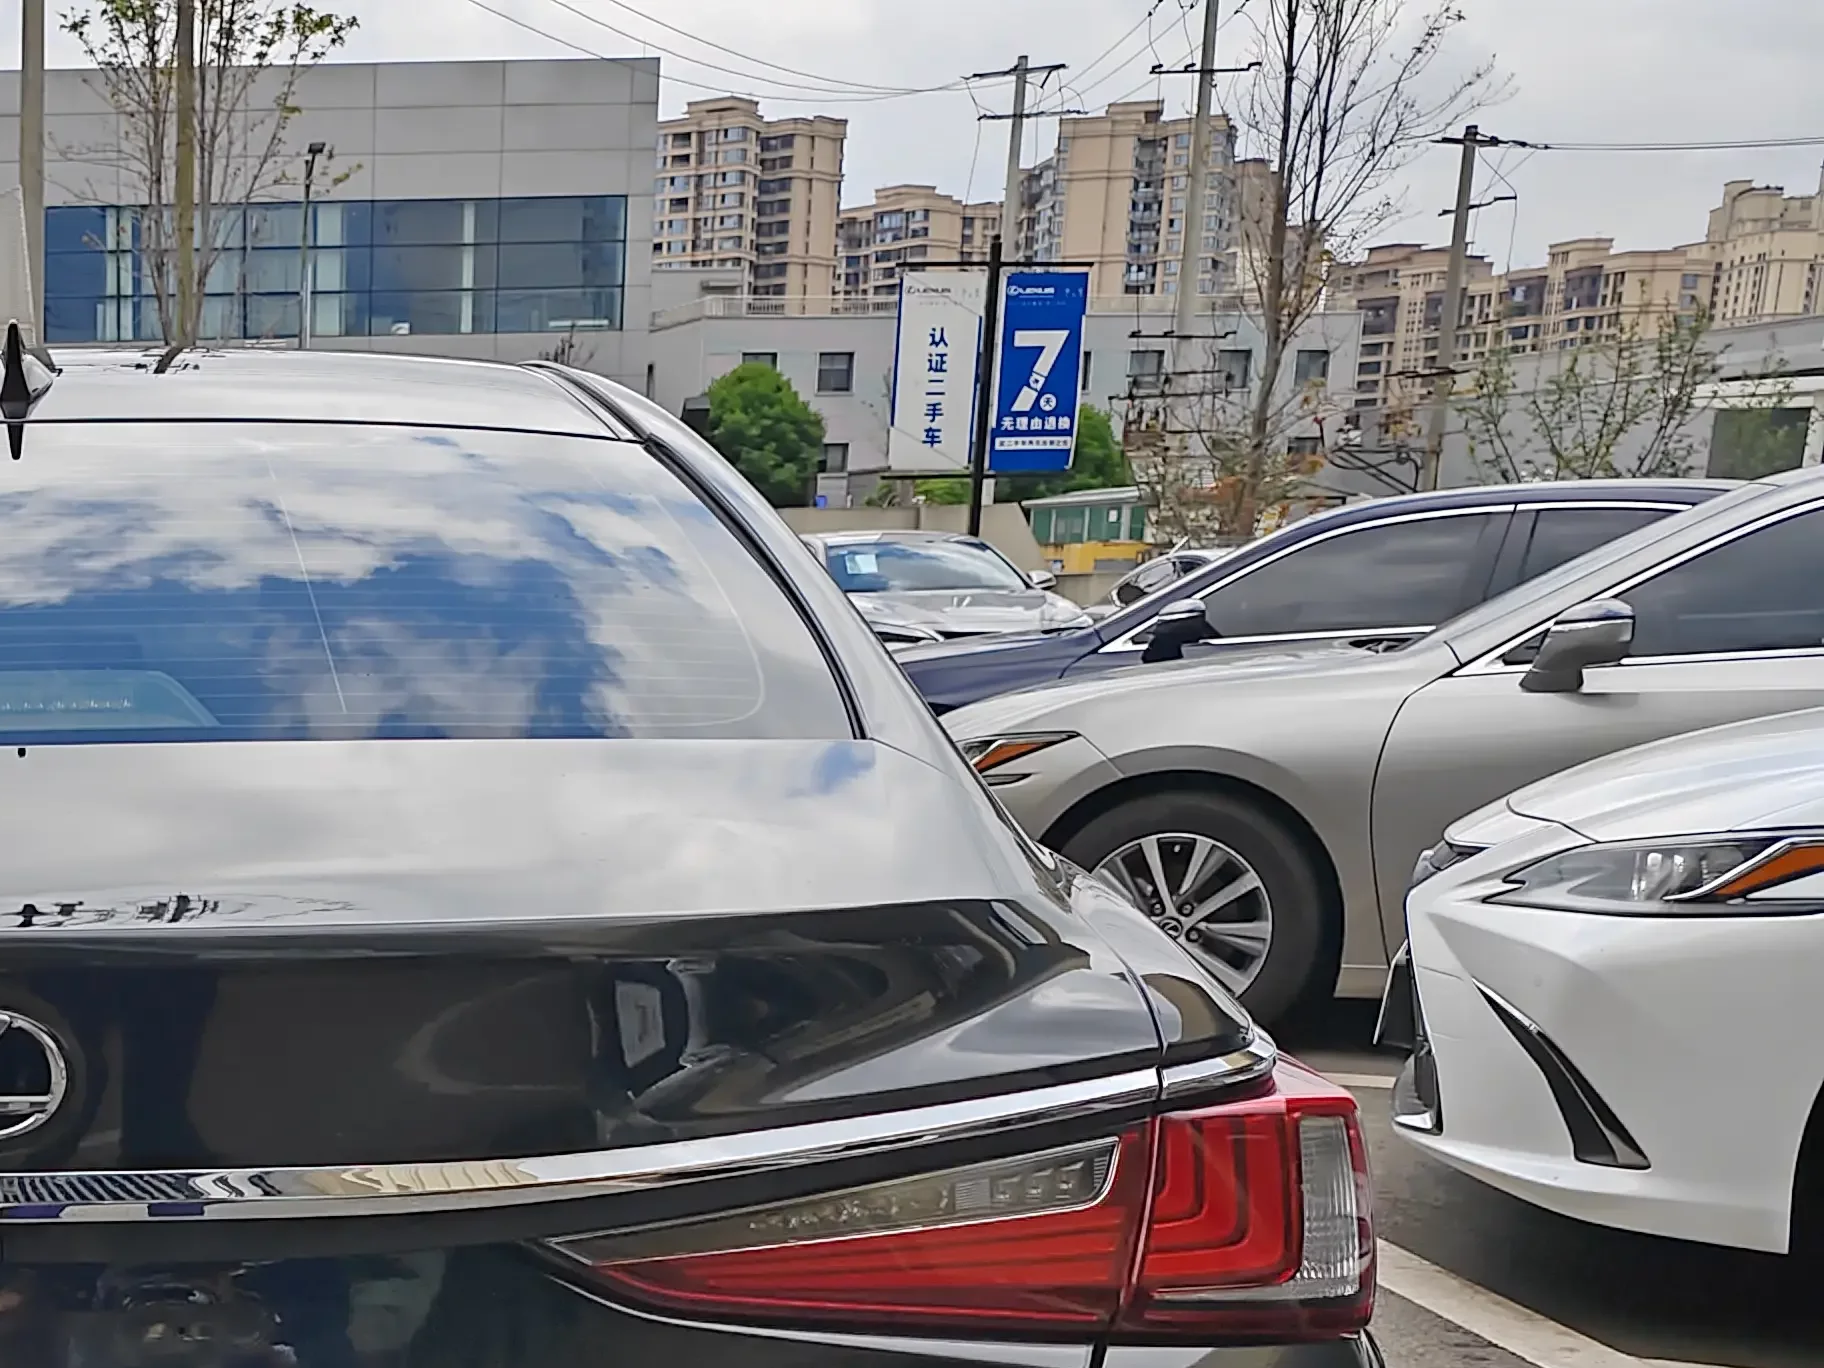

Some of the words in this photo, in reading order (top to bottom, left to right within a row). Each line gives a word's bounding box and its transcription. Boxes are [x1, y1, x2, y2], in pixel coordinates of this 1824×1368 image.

[921, 326, 949, 448] 认证二手车
[1010, 329, 1071, 412] 7
